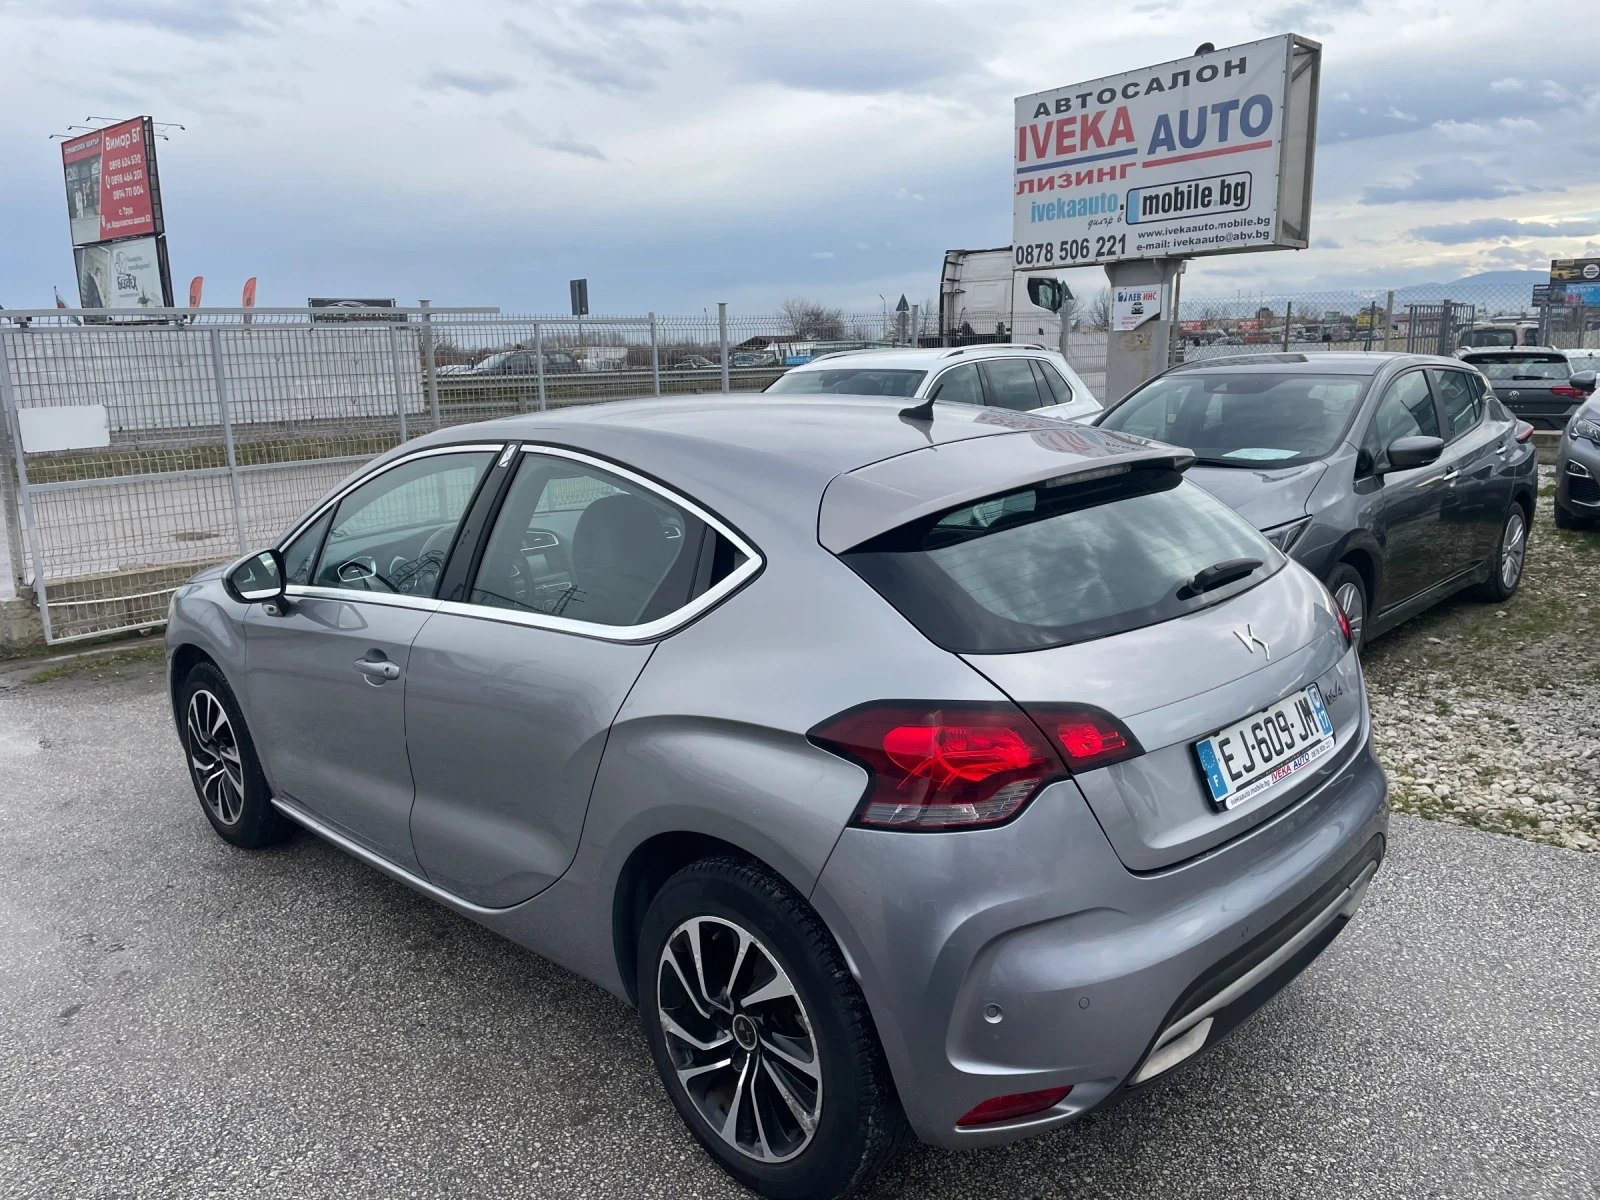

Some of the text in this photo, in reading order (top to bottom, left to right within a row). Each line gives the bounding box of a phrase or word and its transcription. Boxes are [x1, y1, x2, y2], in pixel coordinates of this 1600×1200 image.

[1033, 56, 1247, 119] АВТОСАЛОН
[1018, 94, 1274, 163] IVEKA AUTO
[1016, 162, 1137, 195] ЛИЗИНГ
[1142, 179, 1246, 216] mobile.bg
[1136, 229, 1270, 252] e-mail: ivekaauto@abv.bg
[1137, 216, 1271, 239] www.ivekaauto.mobile.bg
[1015, 233, 1127, 265] 0878 506 221
[1318, 711, 1329, 730] 17
[1212, 774, 1219, 788] F
[1271, 765, 1292, 782] IVEKA
[1293, 752, 1310, 769] AUTO
